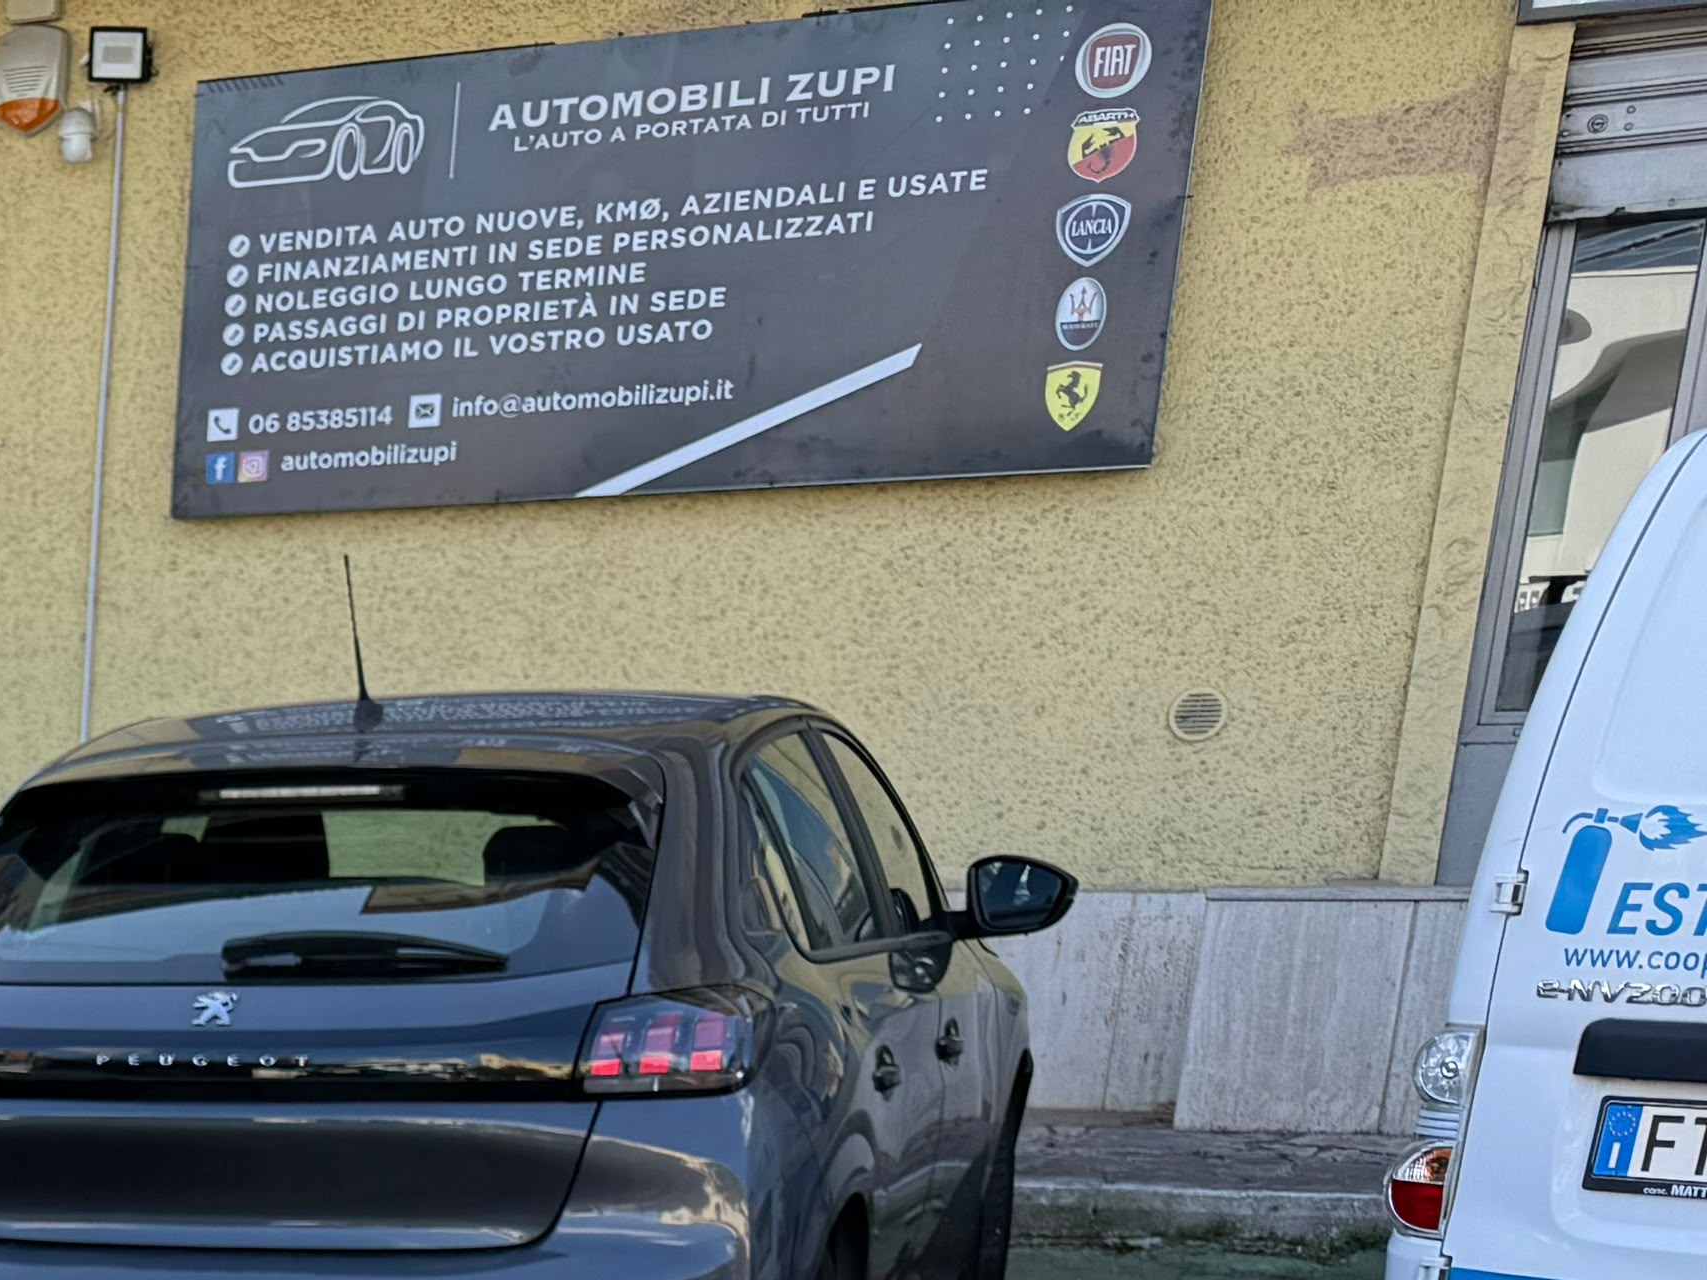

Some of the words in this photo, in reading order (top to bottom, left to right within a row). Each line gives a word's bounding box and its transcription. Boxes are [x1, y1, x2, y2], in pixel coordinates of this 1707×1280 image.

[1093, 44, 1137, 78] FIAT
[489, 77, 771, 132] AUTOMOBILI
[786, 64, 896, 102] ZUPI
[1078, 111, 1136, 125] ABARTH
[514, 129, 602, 153] L'AUTO
[609, 126, 626, 142] A
[635, 113, 752, 140] PORTATA
[761, 109, 786, 128] DI
[796, 101, 870, 125] TUTTI
[259, 224, 377, 254] VENDITA
[387, 216, 465, 243] AUTO
[476, 206, 584, 234] NUOVE,
[680, 181, 846, 217] AZIENDALI
[858, 179, 877, 200] E
[888, 169, 989, 198] USATE
[1071, 218, 1112, 237] LANCIA
[257, 245, 478, 284] FINANZIAMENTI
[488, 241, 518, 264] IN
[528, 235, 603, 261] SEDE
[613, 211, 875, 254] PERSONALIZZATI
[255, 282, 399, 314] NOLEGGIO
[408, 273, 508, 301] LUNGO
[518, 262, 647, 293] TERMINE
[253, 312, 387, 344] PASSAGGI
[397, 310, 426, 333] DI
[436, 292, 598, 329] PROPRIETÀ
[609, 293, 639, 316] IN
[649, 287, 727, 313] SEDE
[250, 339, 444, 374] ACQUISTIAMO
[453, 336, 479, 359] IL
[489, 327, 605, 356] VOSTRO
[616, 319, 713, 347] USATO
[247, 412, 281, 436] 06
[285, 404, 393, 433] 85385114
[451, 378, 734, 420] info@automobilizupi.it
[280, 441, 458, 474] automobilizupi
[96, 1054, 310, 1067] PEUGEOT
